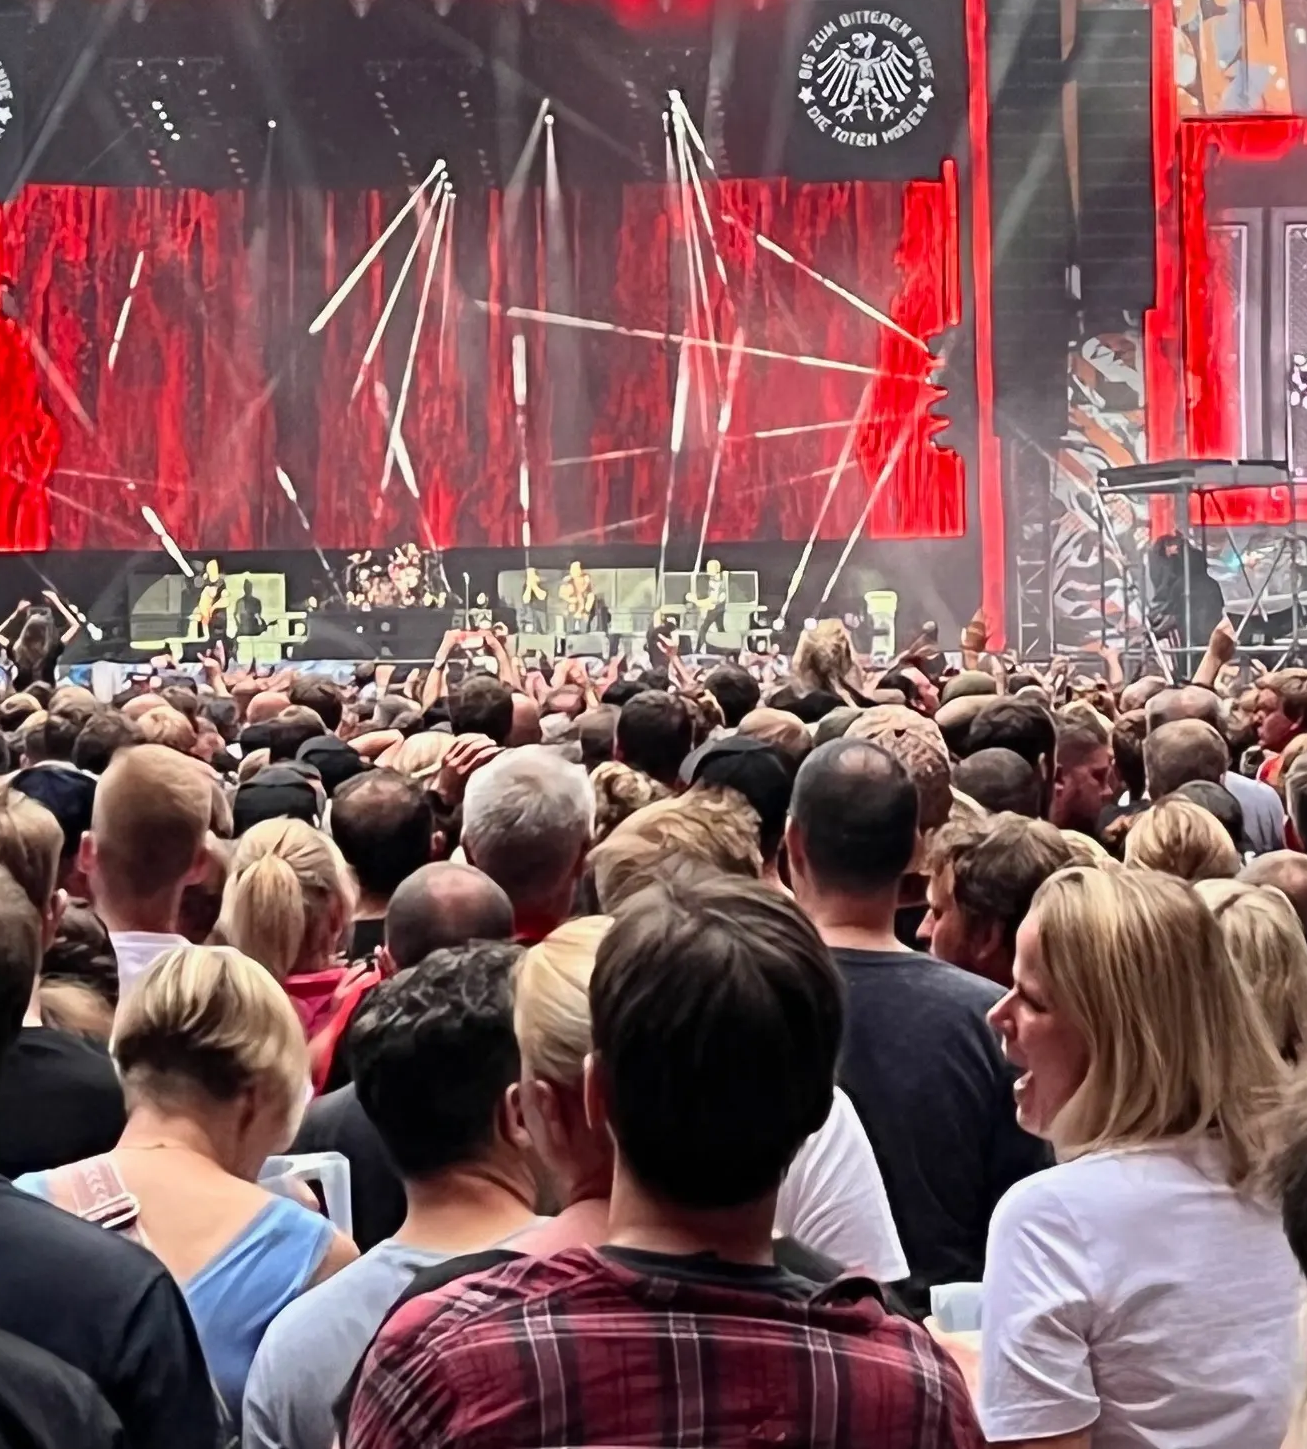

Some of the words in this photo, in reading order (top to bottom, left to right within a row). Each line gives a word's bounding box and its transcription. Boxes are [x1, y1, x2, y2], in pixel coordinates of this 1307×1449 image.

[807, 21, 839, 52] ZUM
[908, 36, 935, 80] ENDE
[806, 105, 833, 132] DIE
[831, 126, 878, 147] TOTEN
